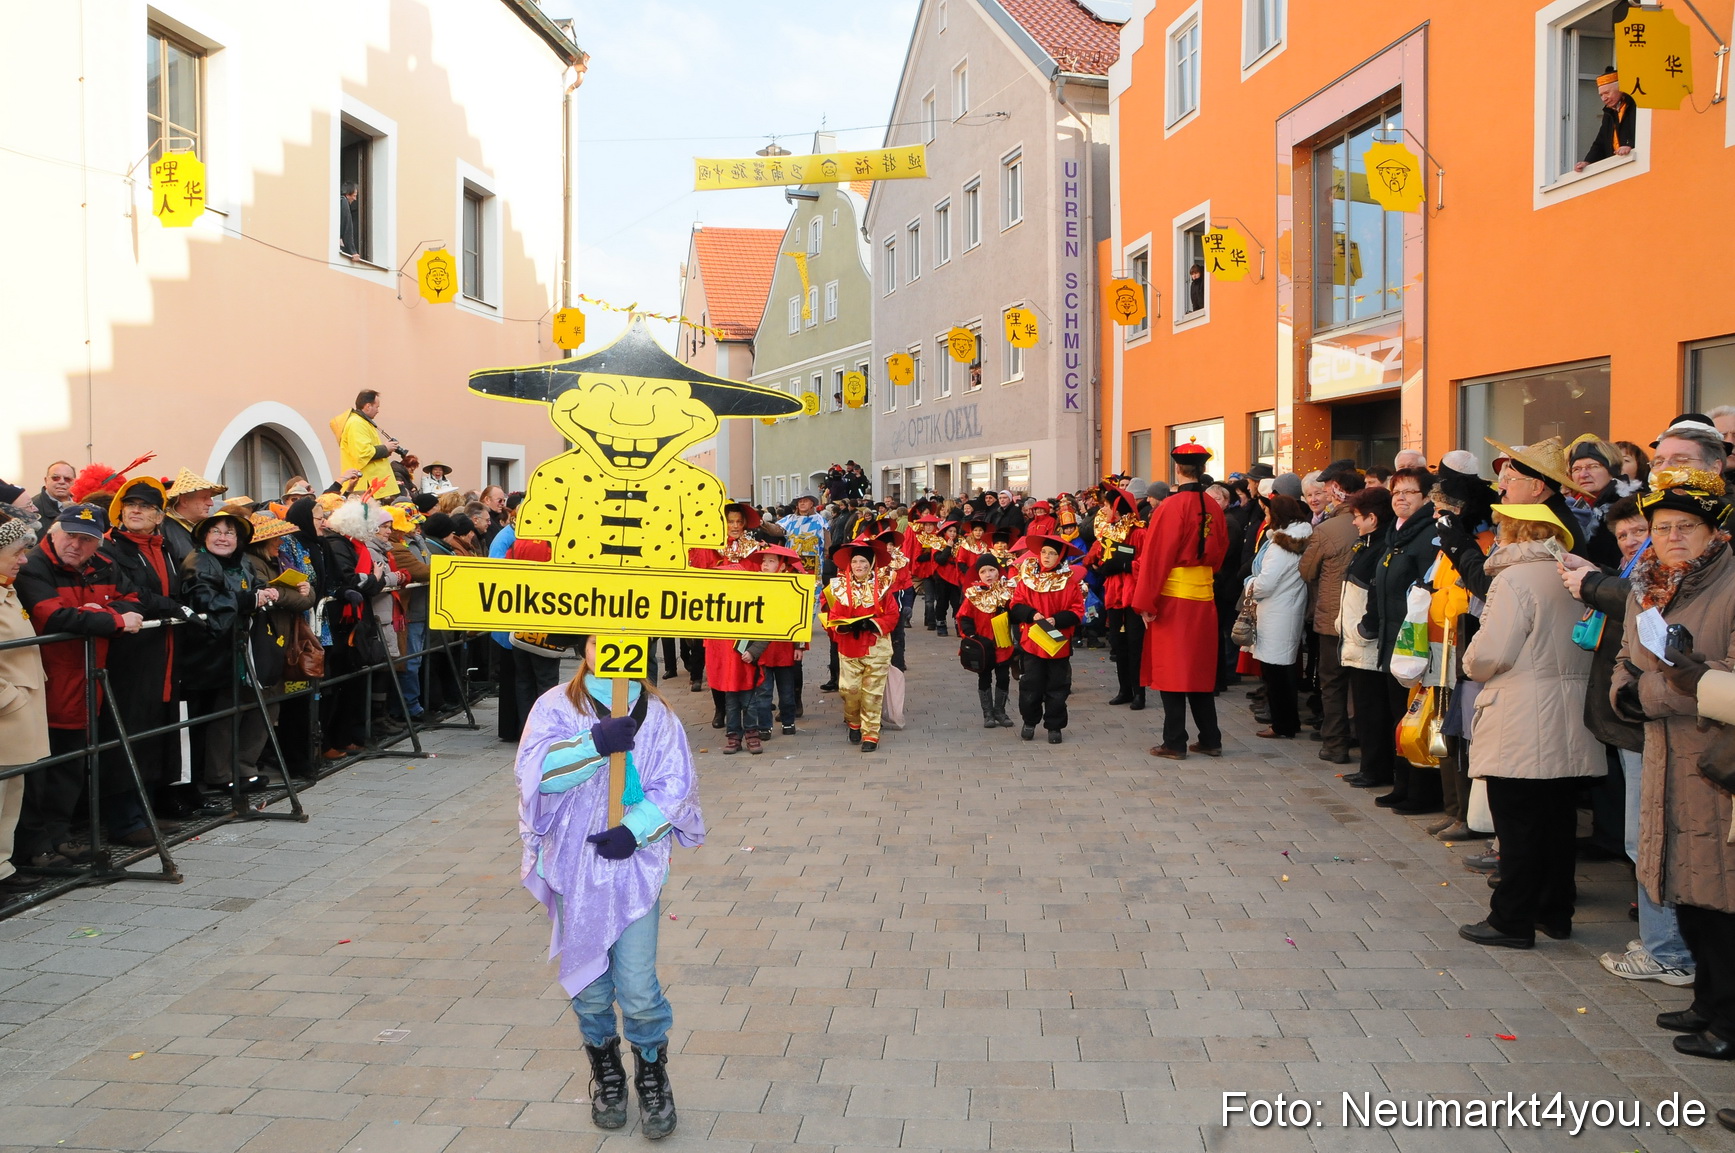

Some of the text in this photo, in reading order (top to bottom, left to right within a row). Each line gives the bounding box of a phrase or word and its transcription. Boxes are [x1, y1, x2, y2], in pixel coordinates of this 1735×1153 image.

[1630, 76, 1647, 95] 人
[158, 193, 175, 217] 人
[1211, 256, 1226, 273] 人
[1064, 162, 1080, 410] UHREN SCHMUCK
[907, 403, 983, 448] OPTIK OEXL
[478, 582, 766, 624] Volksschule Dietfurt
[600, 643, 644, 673] 22
